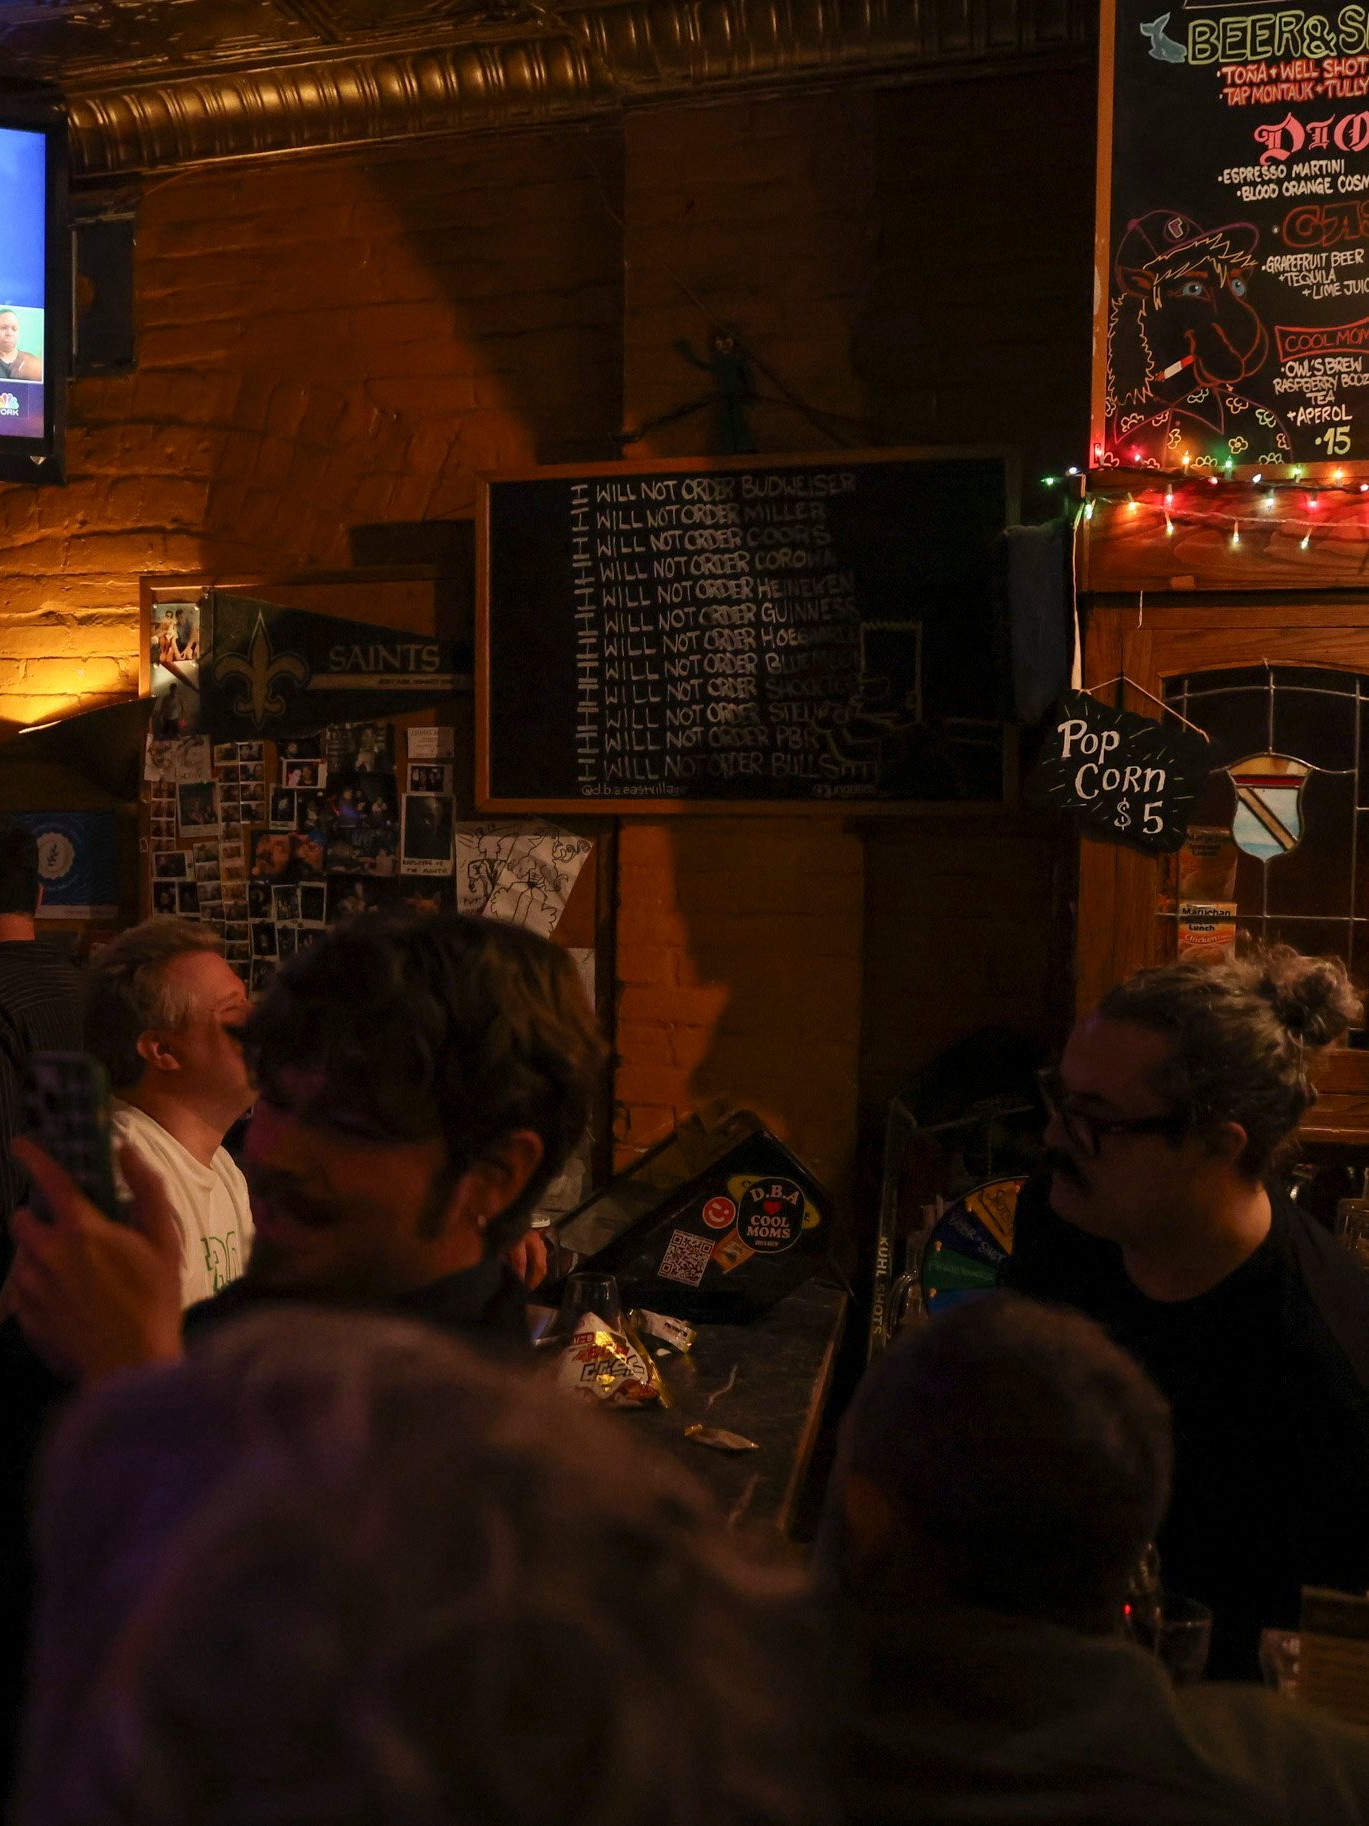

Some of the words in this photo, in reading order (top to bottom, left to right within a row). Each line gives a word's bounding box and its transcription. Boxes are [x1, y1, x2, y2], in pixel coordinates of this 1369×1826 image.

[1281, 58, 1320, 82] WELL
[1322, 55, 1369, 79] SHOT
[1222, 86, 1250, 106] TAP
[1252, 81, 1314, 104] MONTAUK
[1223, 164, 1287, 184] ESPRESSO
[1292, 159, 1345, 178] MARTINI
[1241, 183, 1279, 201] BLOOD
[1282, 177, 1334, 197] ORANGE
[1266, 253, 1329, 274] GRAPEFRUIT
[1331, 248, 1365, 267] BEER
[1313, 282, 1342, 300] LIME
[1285, 333, 1336, 352] COOL
[1324, 355, 1362, 375] BREW
[1273, 375, 1338, 395] RASPBERRY
[1306, 389, 1335, 405] TEA
[597, 484, 637, 502] WILL
[641, 480, 678, 500] NOT
[681, 479, 735, 501] ORDER
[597, 510, 643, 531] WILL
[647, 505, 681, 528] NOT
[681, 504, 740, 525] ORDER
[597, 534, 646, 558] WILL
[650, 530, 683, 552] NOT
[684, 527, 743, 550] ORDER
[600, 560, 648, 583] WILL
[653, 557, 687, 578] NOT
[690, 550, 750, 576] ORDER
[603, 586, 651, 608] WILL
[657, 581, 693, 604] NOT
[695, 576, 753, 599] ORDER
[605, 612, 653, 635] WILL
[659, 607, 696, 632] NOT
[699, 603, 757, 626] ORDER
[604, 636, 656, 657] WILL
[663, 631, 701, 654] NOT
[703, 627, 756, 650] ORDER
[329, 643, 440, 672] SAINTS
[605, 660, 659, 681] WILL
[664, 655, 702, 678] NOT
[703, 652, 757, 674] ORDER
[605, 684, 662, 705] WILL
[668, 679, 704, 702] NOT
[707, 676, 757, 698] ORDER
[606, 707, 659, 729] WILL
[666, 704, 704, 726] NOT
[605, 731, 660, 753] WILL
[666, 727, 704, 748] NOT
[603, 755, 659, 781] WILL
[665, 753, 706, 779] NOT
[747, 1226, 791, 1239] MOMS
[750, 1215, 790, 1228] COOL
